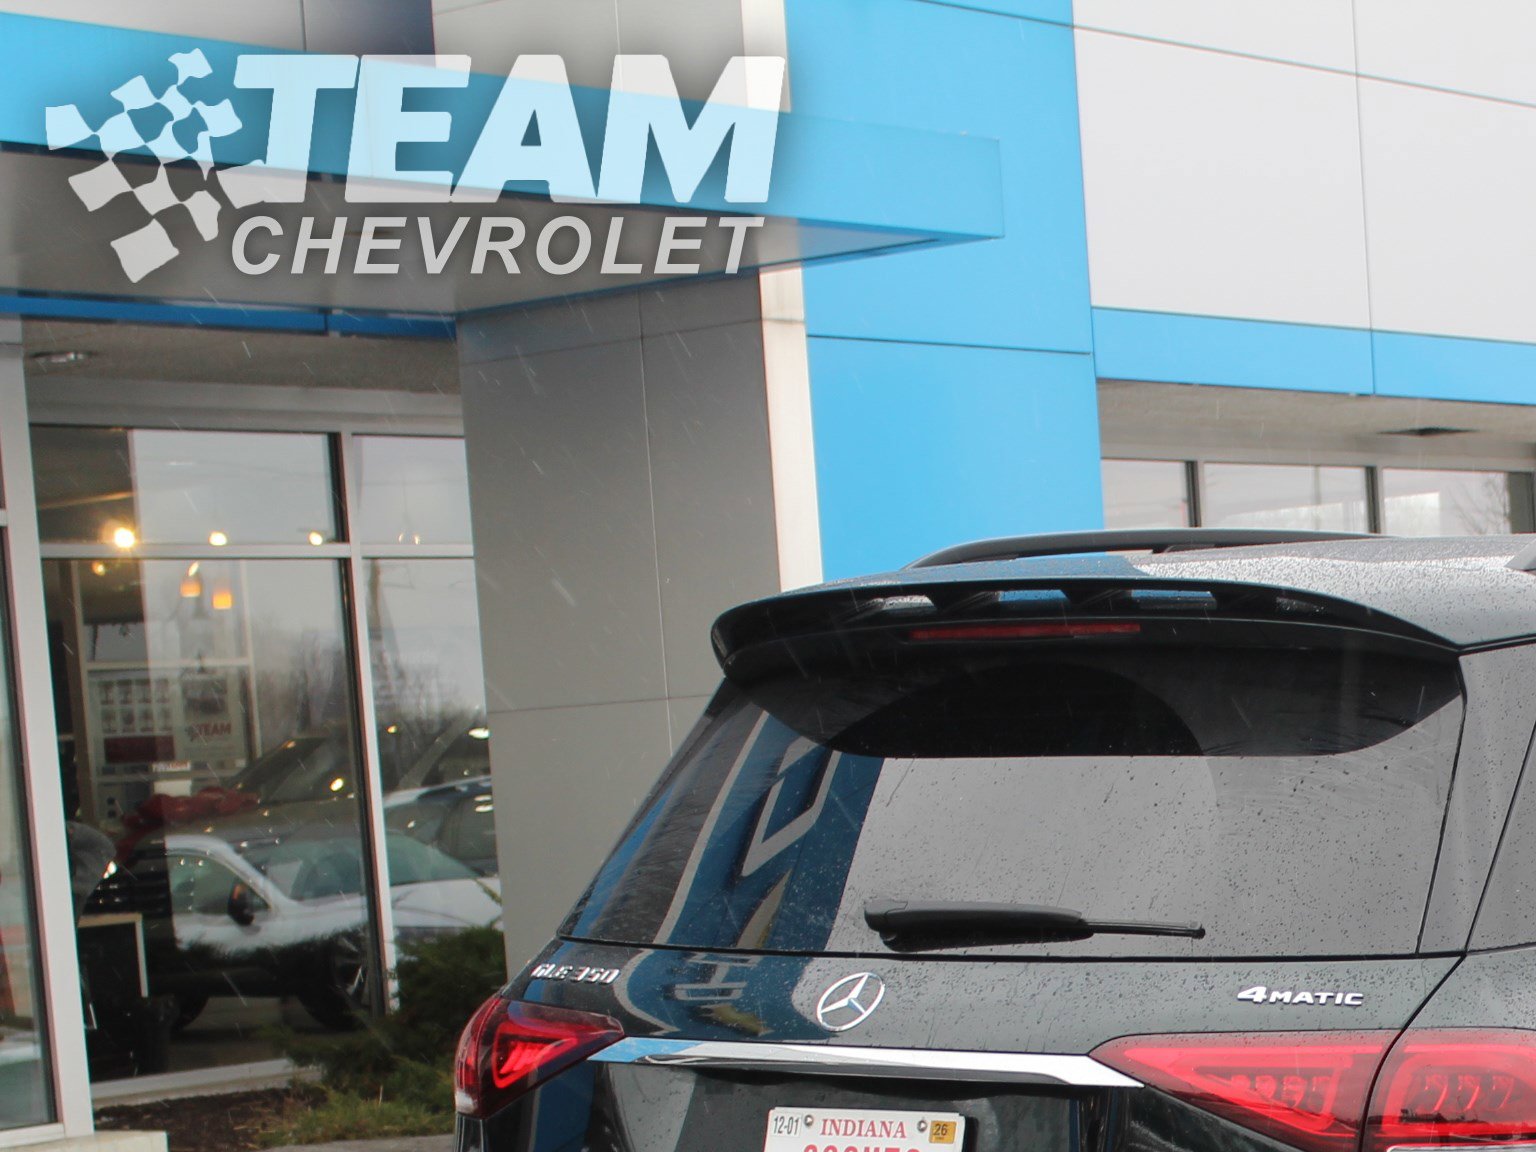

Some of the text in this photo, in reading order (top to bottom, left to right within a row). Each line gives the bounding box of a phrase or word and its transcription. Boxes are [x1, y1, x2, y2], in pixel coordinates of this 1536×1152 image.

[531, 963, 621, 984] GLE 350
[1237, 986, 1364, 1005] 4MATIC
[773, 1115, 800, 1135] 12-01
[819, 1118, 907, 1138] INDIANA
[932, 1123, 948, 1136] 26
